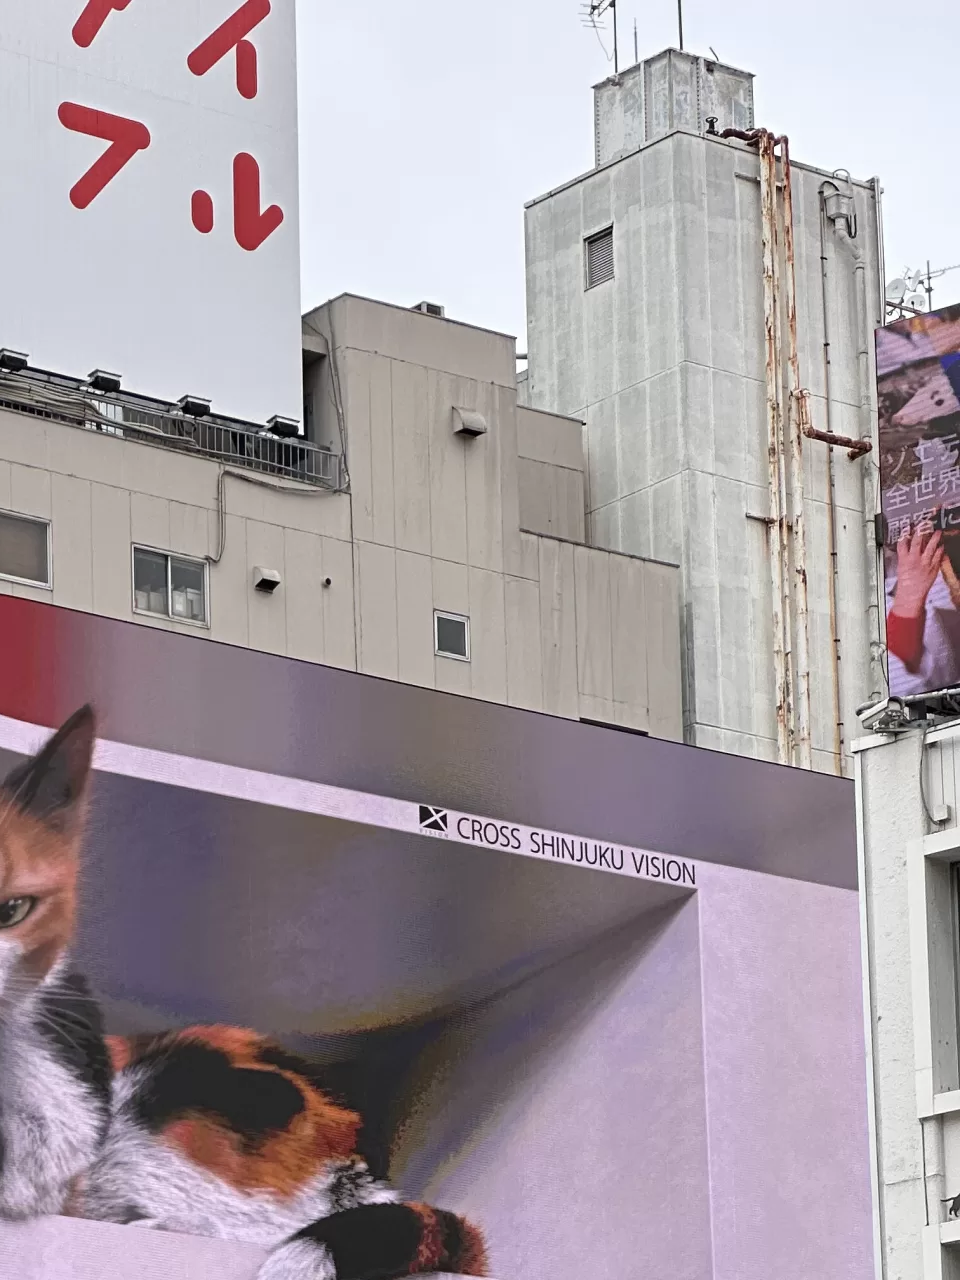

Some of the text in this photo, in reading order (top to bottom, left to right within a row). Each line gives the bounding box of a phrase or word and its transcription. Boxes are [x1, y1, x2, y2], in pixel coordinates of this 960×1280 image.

[57, 101, 285, 252] フル
[457, 817, 696, 884] CROSS SHINJUKU VISION
